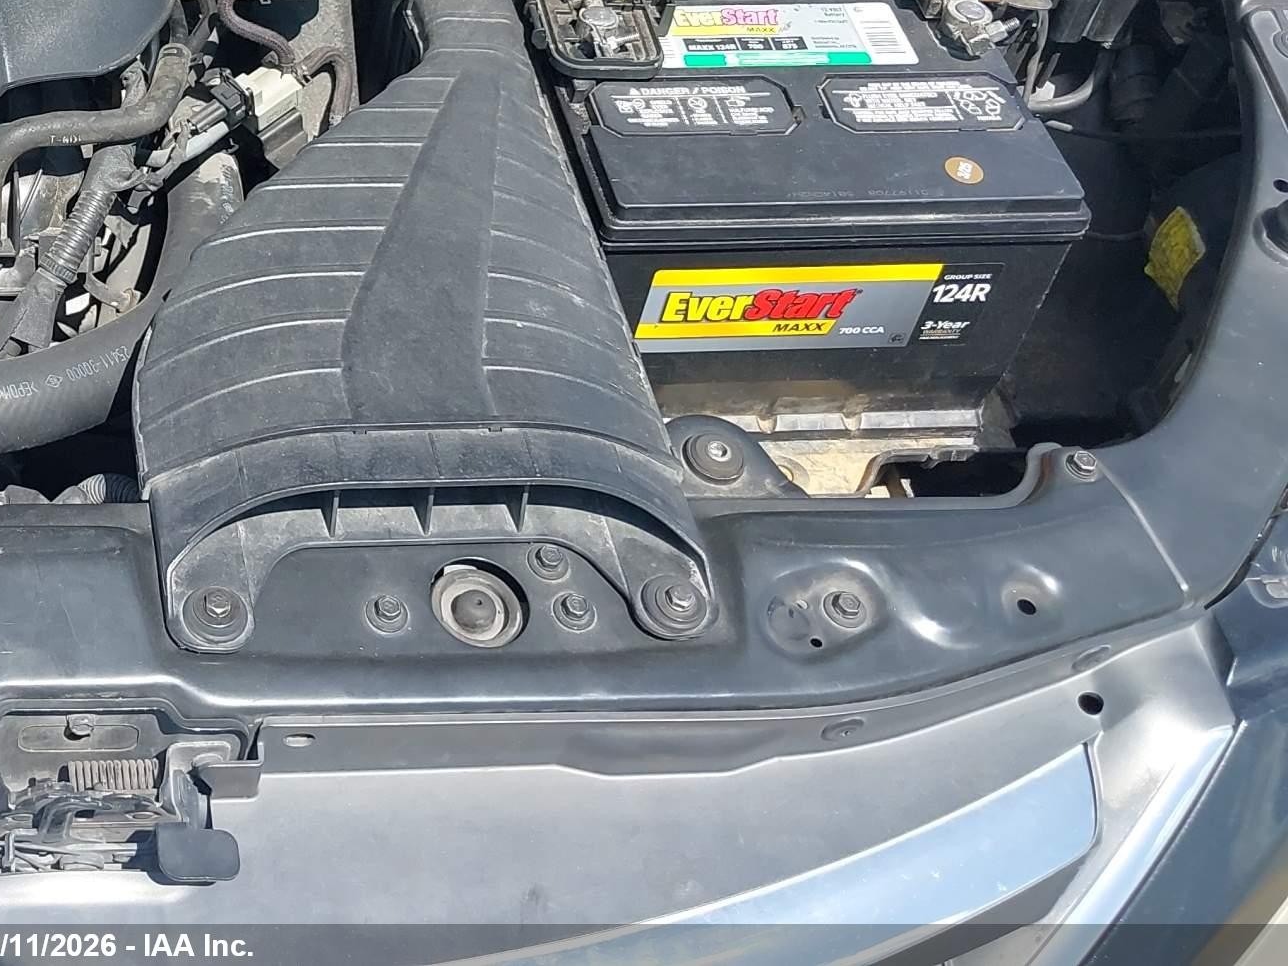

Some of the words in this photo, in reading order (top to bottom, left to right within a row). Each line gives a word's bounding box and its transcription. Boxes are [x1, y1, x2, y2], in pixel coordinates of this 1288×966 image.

[673, 8, 779, 27] EverStart
[640, 87, 690, 95] DANGER
[701, 86, 746, 94] POISON
[932, 283, 992, 303] 124R
[661, 288, 860, 323] EverStart
[772, 322, 827, 333] MAXX
[839, 326, 861, 334] 700
[862, 326, 885, 334] CCA
[920, 320, 971, 330] 3-Year
